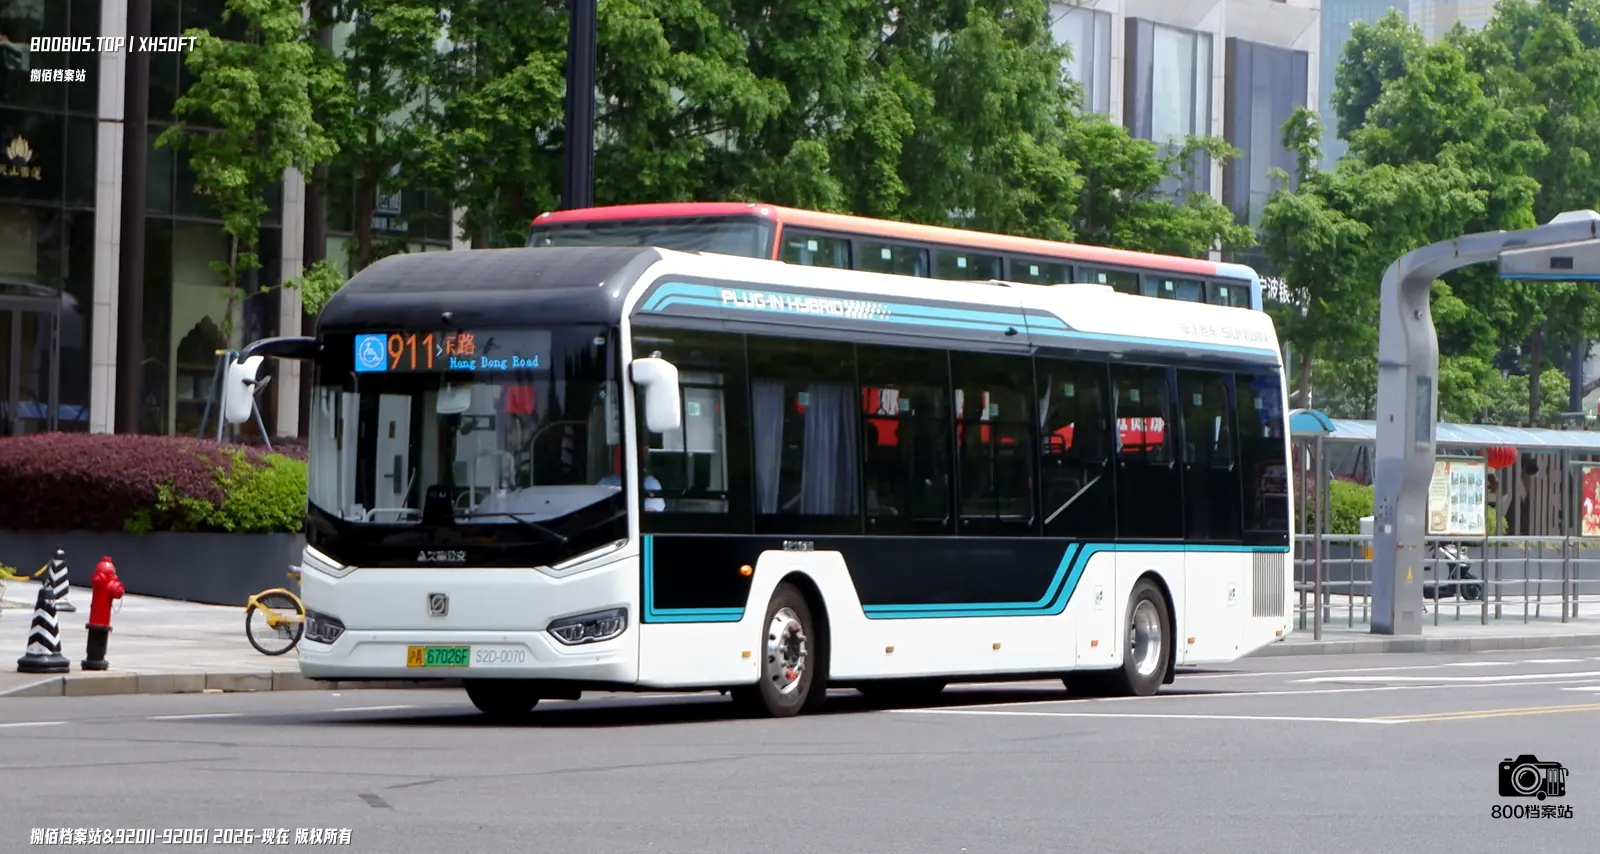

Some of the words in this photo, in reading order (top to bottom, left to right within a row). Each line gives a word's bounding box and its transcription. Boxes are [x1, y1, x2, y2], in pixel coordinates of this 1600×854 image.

[721, 289, 785, 311] PLUG-IN
[787, 296, 845, 315] HYBRID
[387, 333, 434, 370] 911
[450, 356, 477, 370] Hang
[481, 356, 508, 369] Dong
[512, 355, 540, 368] Road
[475, 649, 526, 663] S2D-0070
